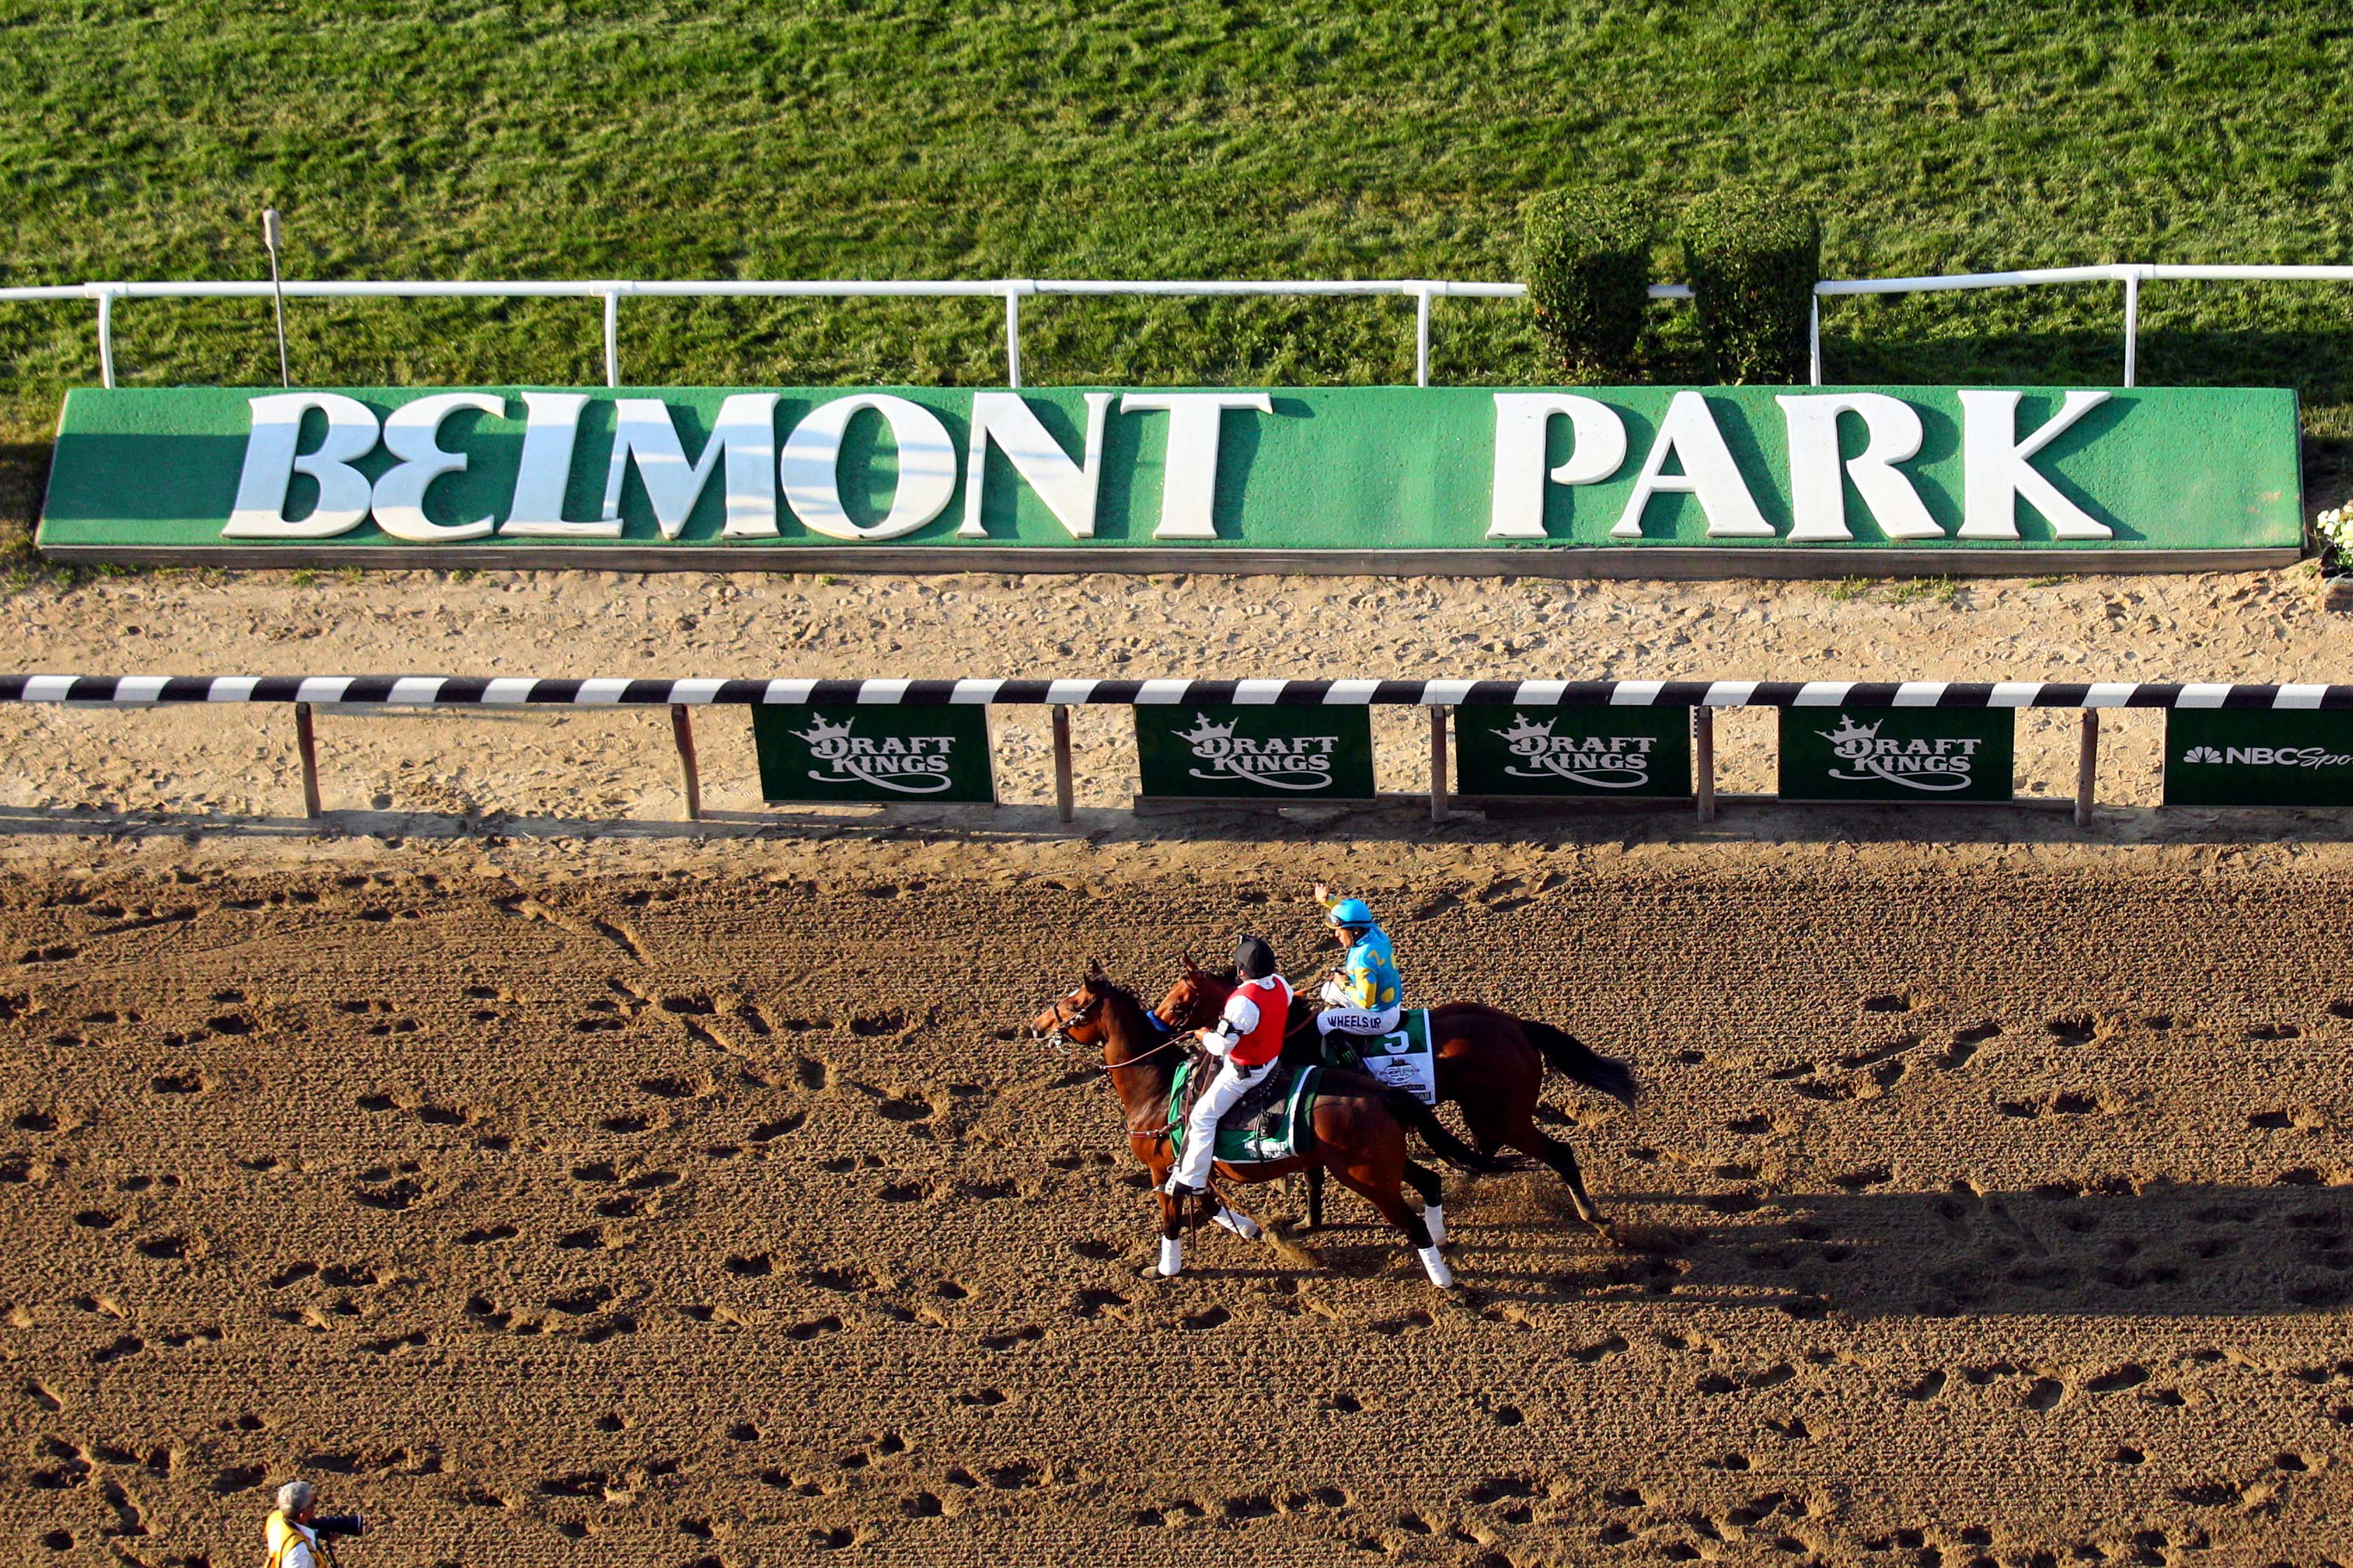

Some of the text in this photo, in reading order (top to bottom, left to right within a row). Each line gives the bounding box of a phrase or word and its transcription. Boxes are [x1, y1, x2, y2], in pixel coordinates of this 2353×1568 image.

[220, 390, 2113, 541] BELMONT PARK
[811, 737, 956, 759] DRAFT
[1192, 737, 1339, 758] DRAFT
[1509, 735, 1657, 756] DRAFT
[1833, 738, 1981, 758] DRAFT
[1327, 1015, 1381, 1029] WHEELS UP
